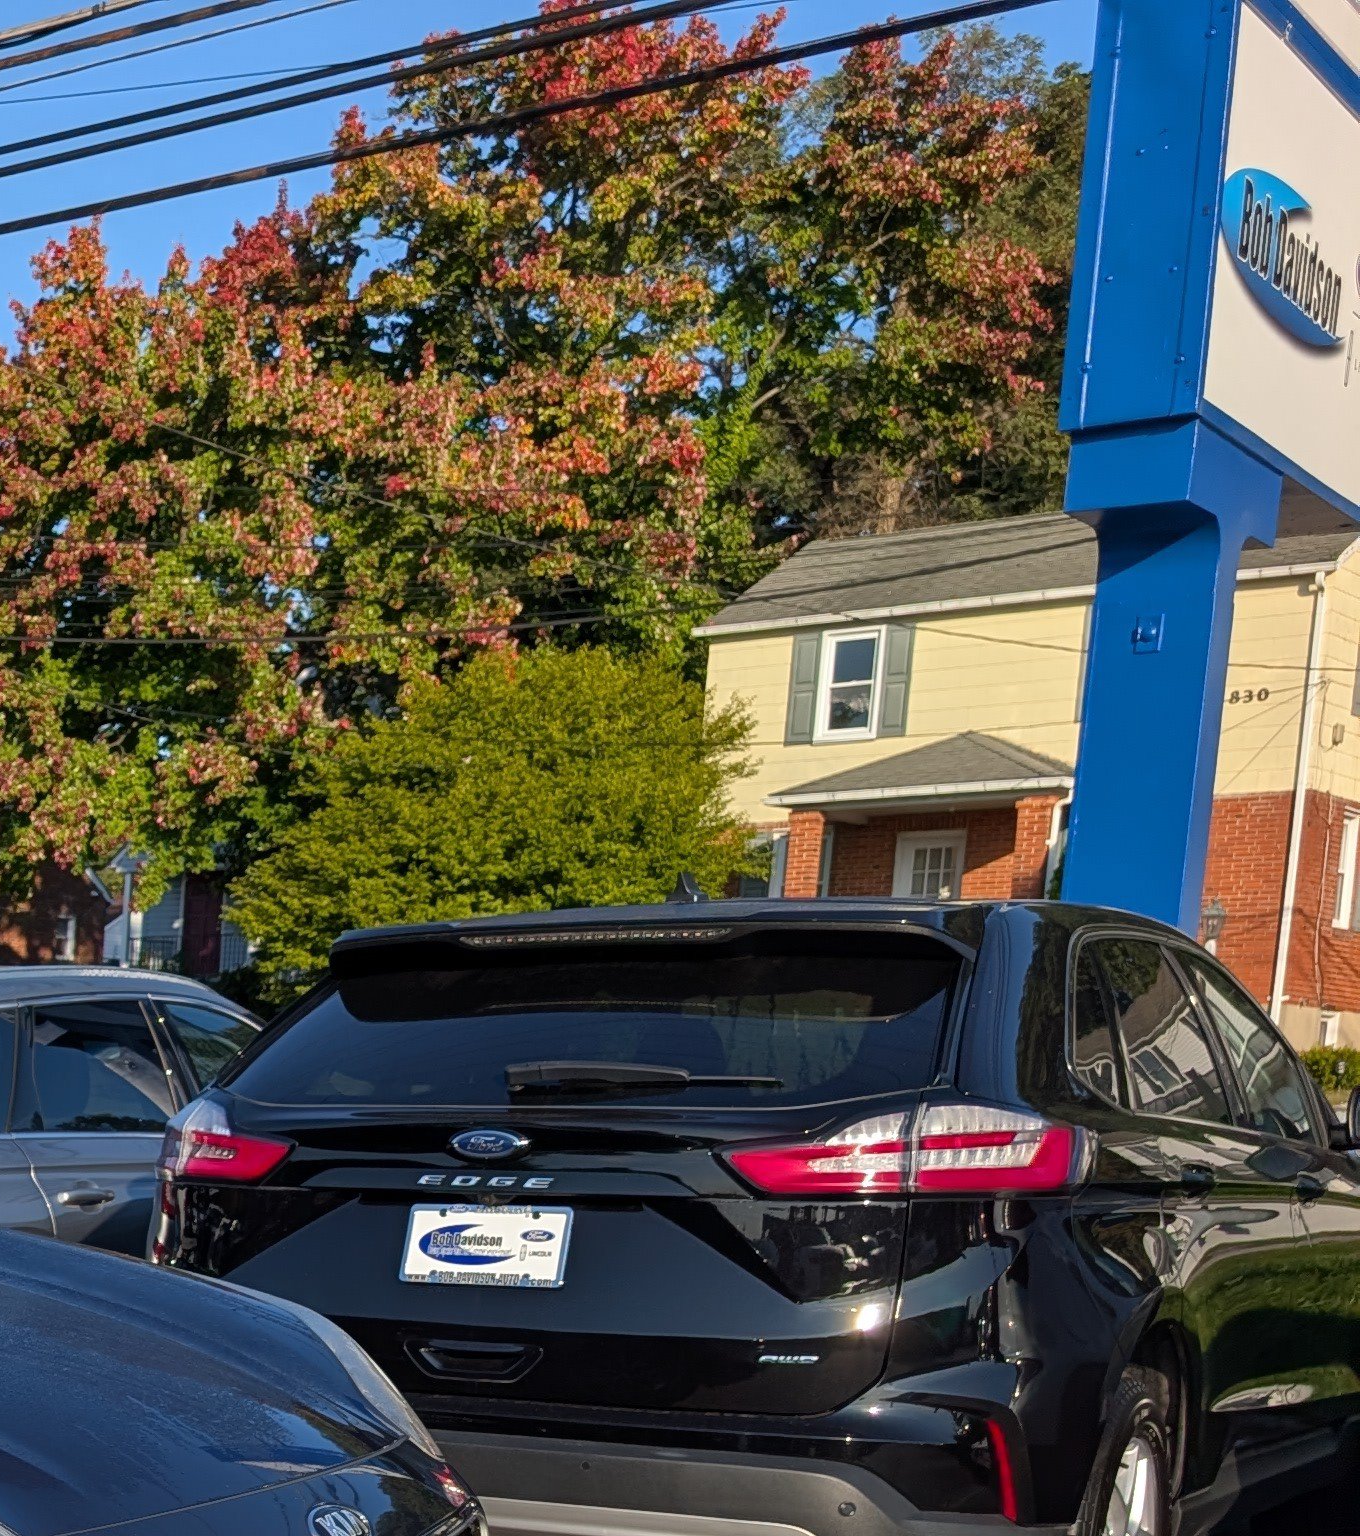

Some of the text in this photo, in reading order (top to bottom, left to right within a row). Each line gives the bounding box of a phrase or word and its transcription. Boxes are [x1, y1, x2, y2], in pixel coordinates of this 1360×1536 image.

[1237, 174, 1342, 339] Bob Davidson
[1229, 688, 1270, 704] 830
[417, 1174, 555, 1189] EDGE
[431, 1231, 503, 1247] Bob Davidson
